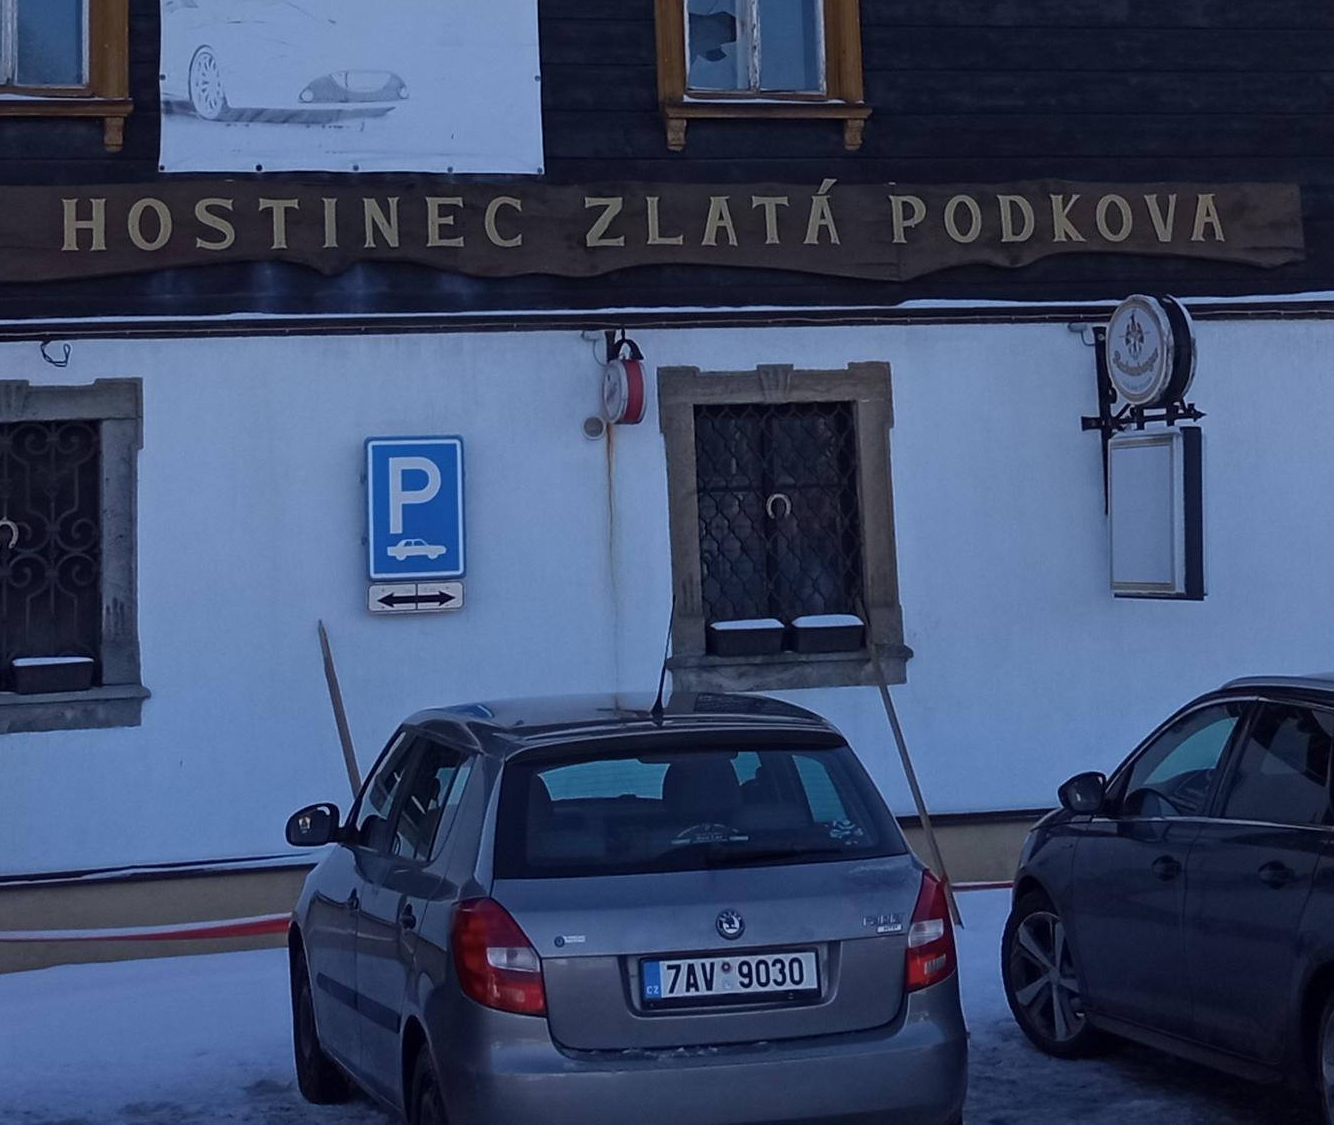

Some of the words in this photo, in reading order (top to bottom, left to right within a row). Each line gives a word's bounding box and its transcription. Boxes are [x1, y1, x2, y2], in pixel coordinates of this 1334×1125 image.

[61, 196, 523, 252] HOSTINEC
[584, 179, 841, 248] ZLATÁ
[888, 193, 1226, 245] PODKOVA
[388, 456, 442, 535] P
[667, 961, 716, 994] 7AV
[737, 957, 804, 989] 9030
